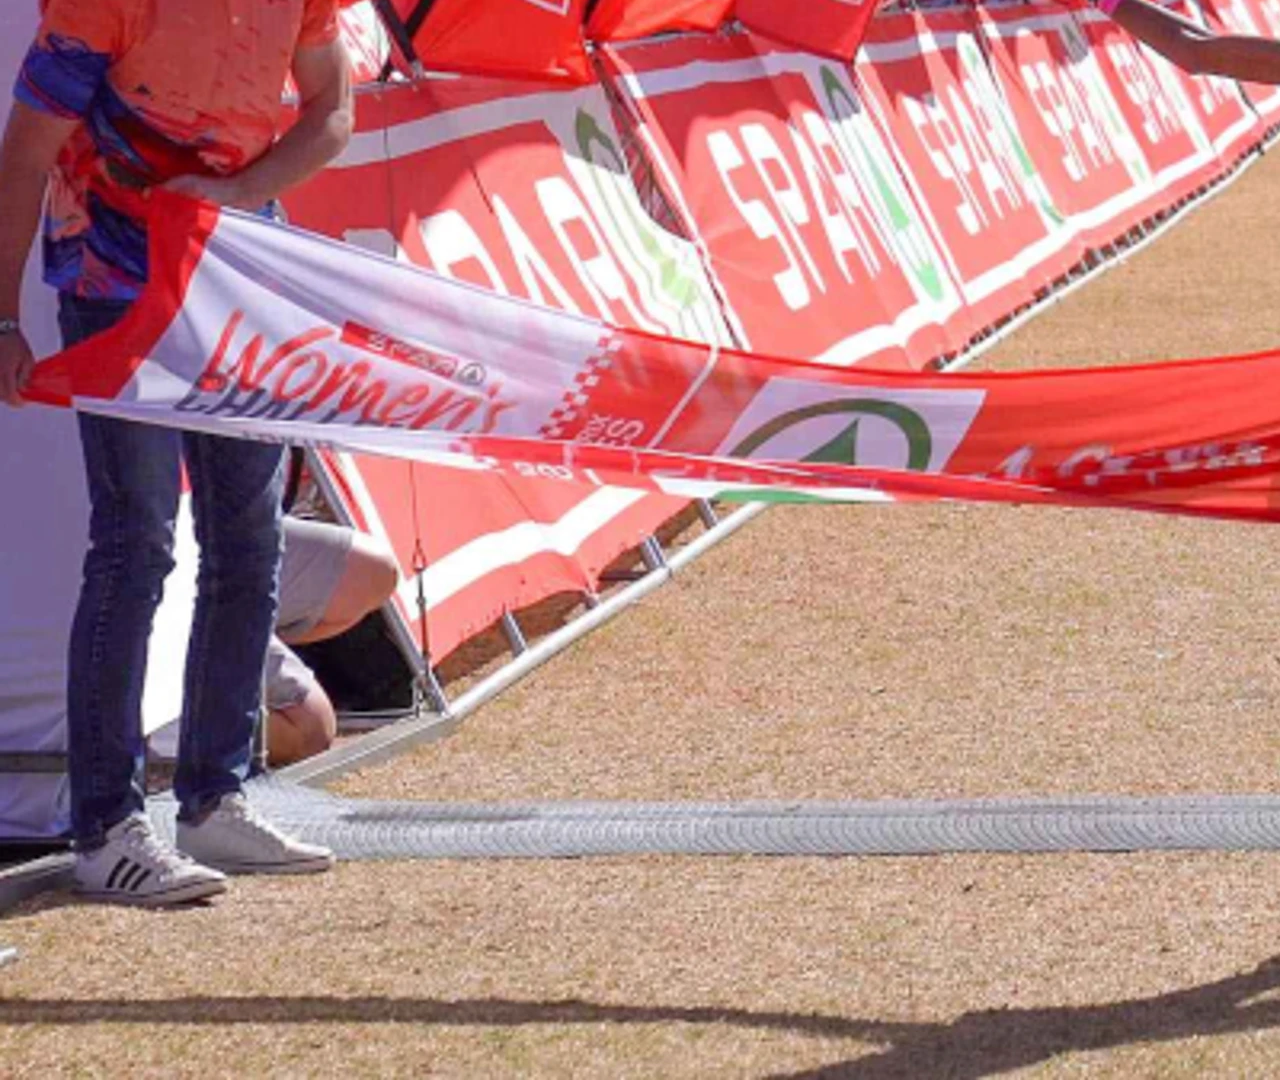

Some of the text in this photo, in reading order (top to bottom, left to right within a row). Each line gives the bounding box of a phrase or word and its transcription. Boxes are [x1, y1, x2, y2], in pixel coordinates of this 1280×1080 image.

[707, 111, 884, 311] SPAR
[906, 81, 1024, 236] SPAR
[199, 308, 519, 434] Women's
